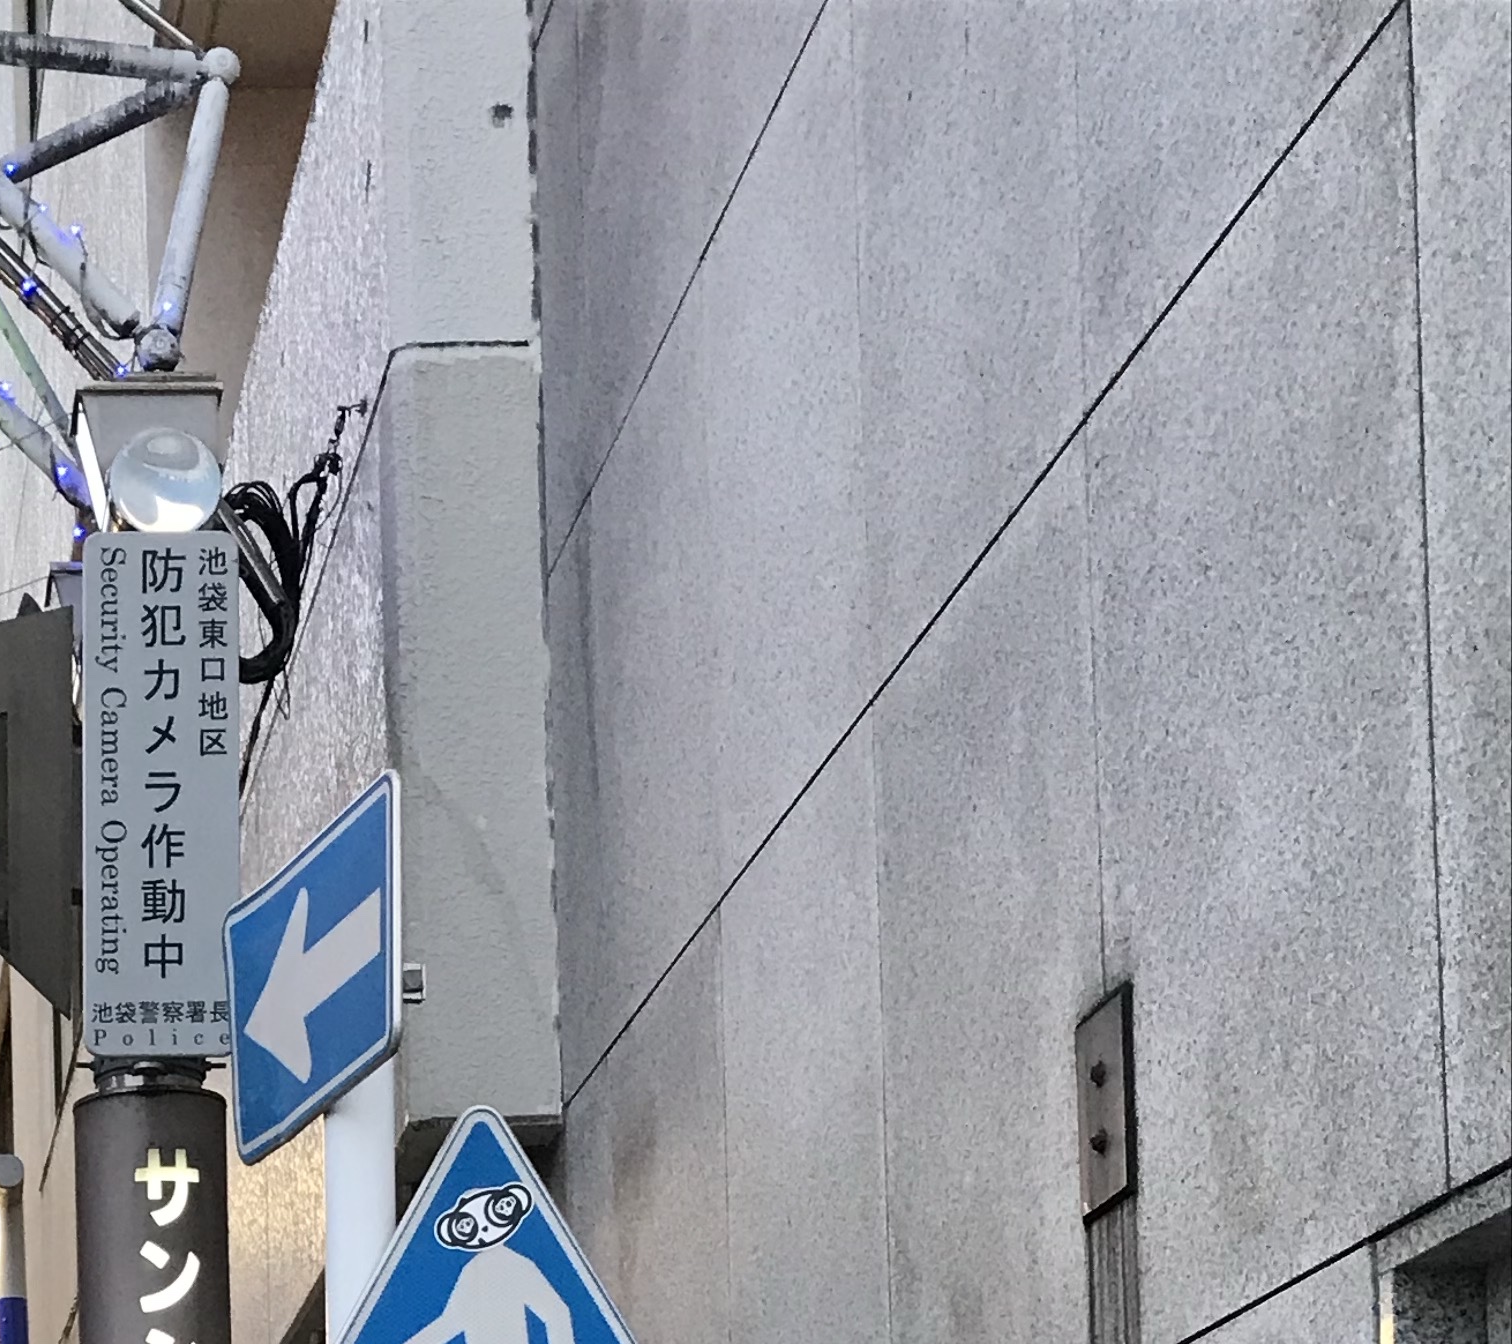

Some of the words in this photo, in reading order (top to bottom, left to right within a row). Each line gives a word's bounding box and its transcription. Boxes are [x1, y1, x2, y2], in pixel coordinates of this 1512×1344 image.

[95, 546, 128, 674] Security
[198, 546, 229, 757] 池袋東口地区
[99, 687, 128, 808] Camera
[140, 547, 187, 980] 防犯カメラ作動中
[95, 819, 128, 976] Operating
[91, 1000, 230, 1026] 池袋警察署長
